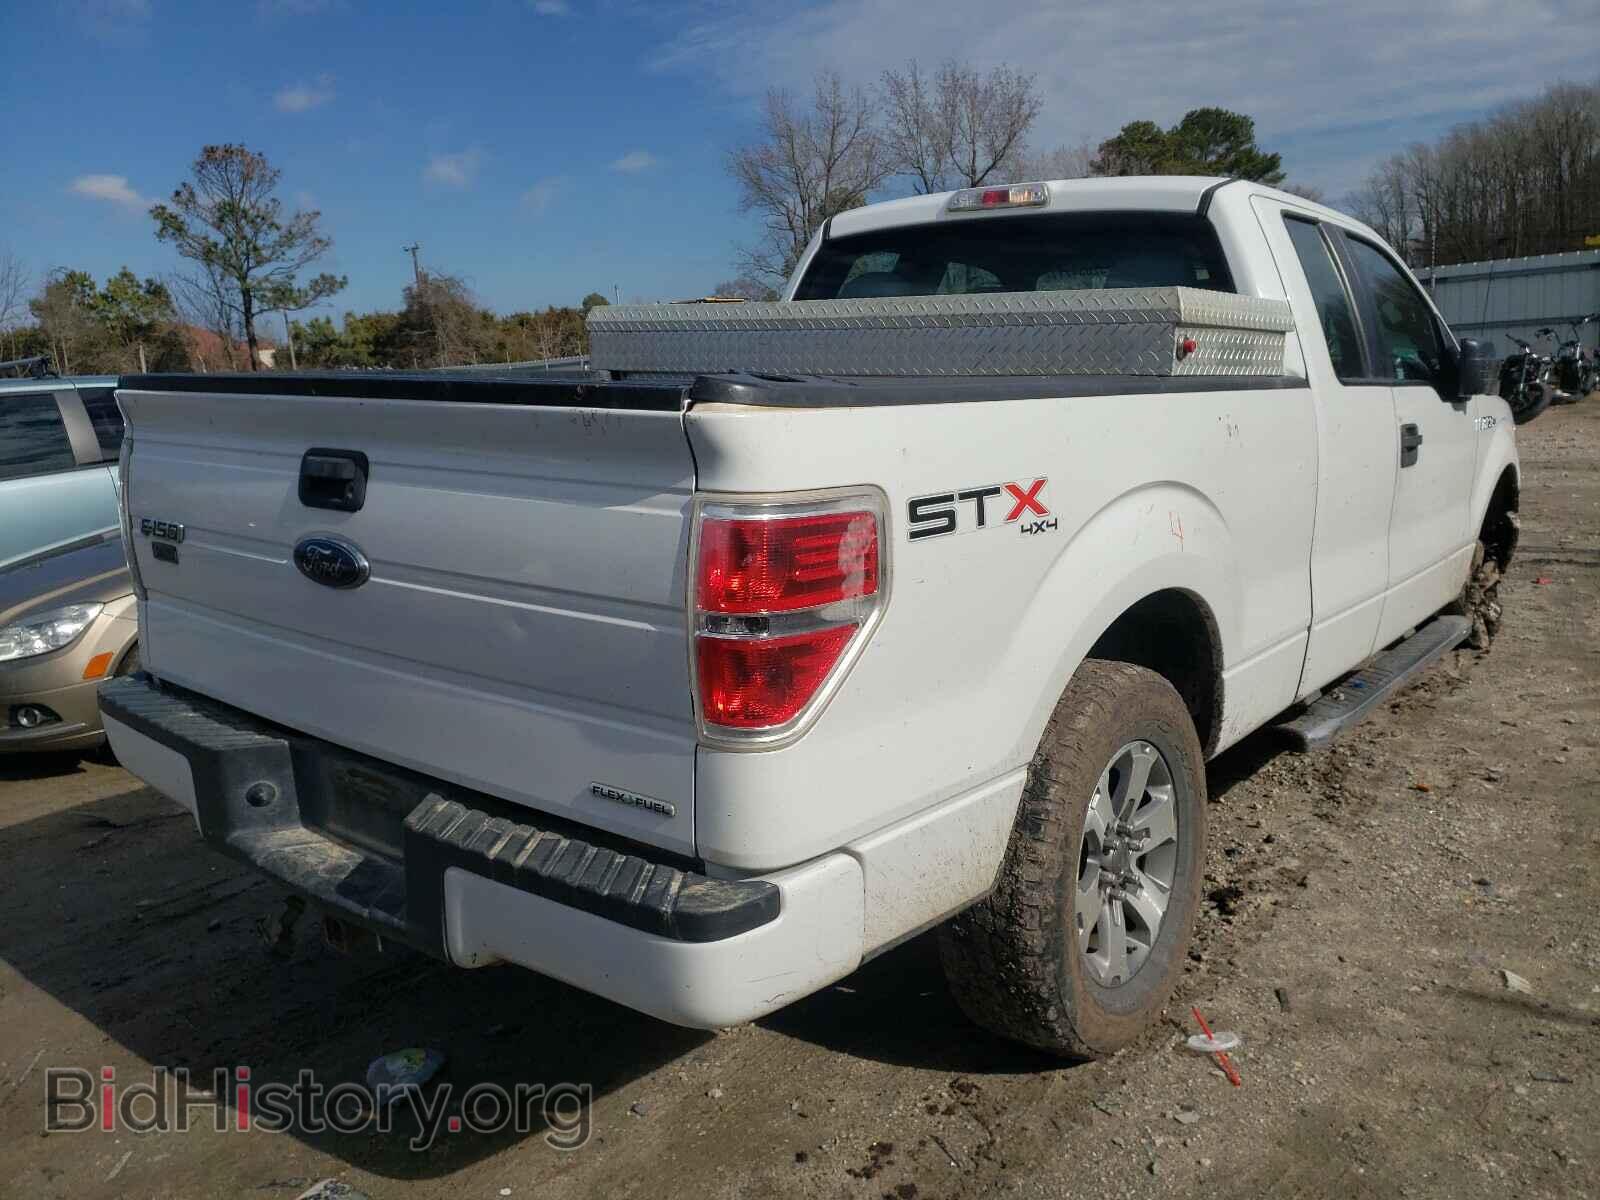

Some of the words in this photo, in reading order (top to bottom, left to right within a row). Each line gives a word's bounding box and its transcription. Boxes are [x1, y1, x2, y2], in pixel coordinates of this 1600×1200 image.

[907, 478, 1050, 541] STX
[303, 545, 344, 578] Ford
[592, 785, 624, 802] FLEX
[635, 797, 665, 813] FUEL
